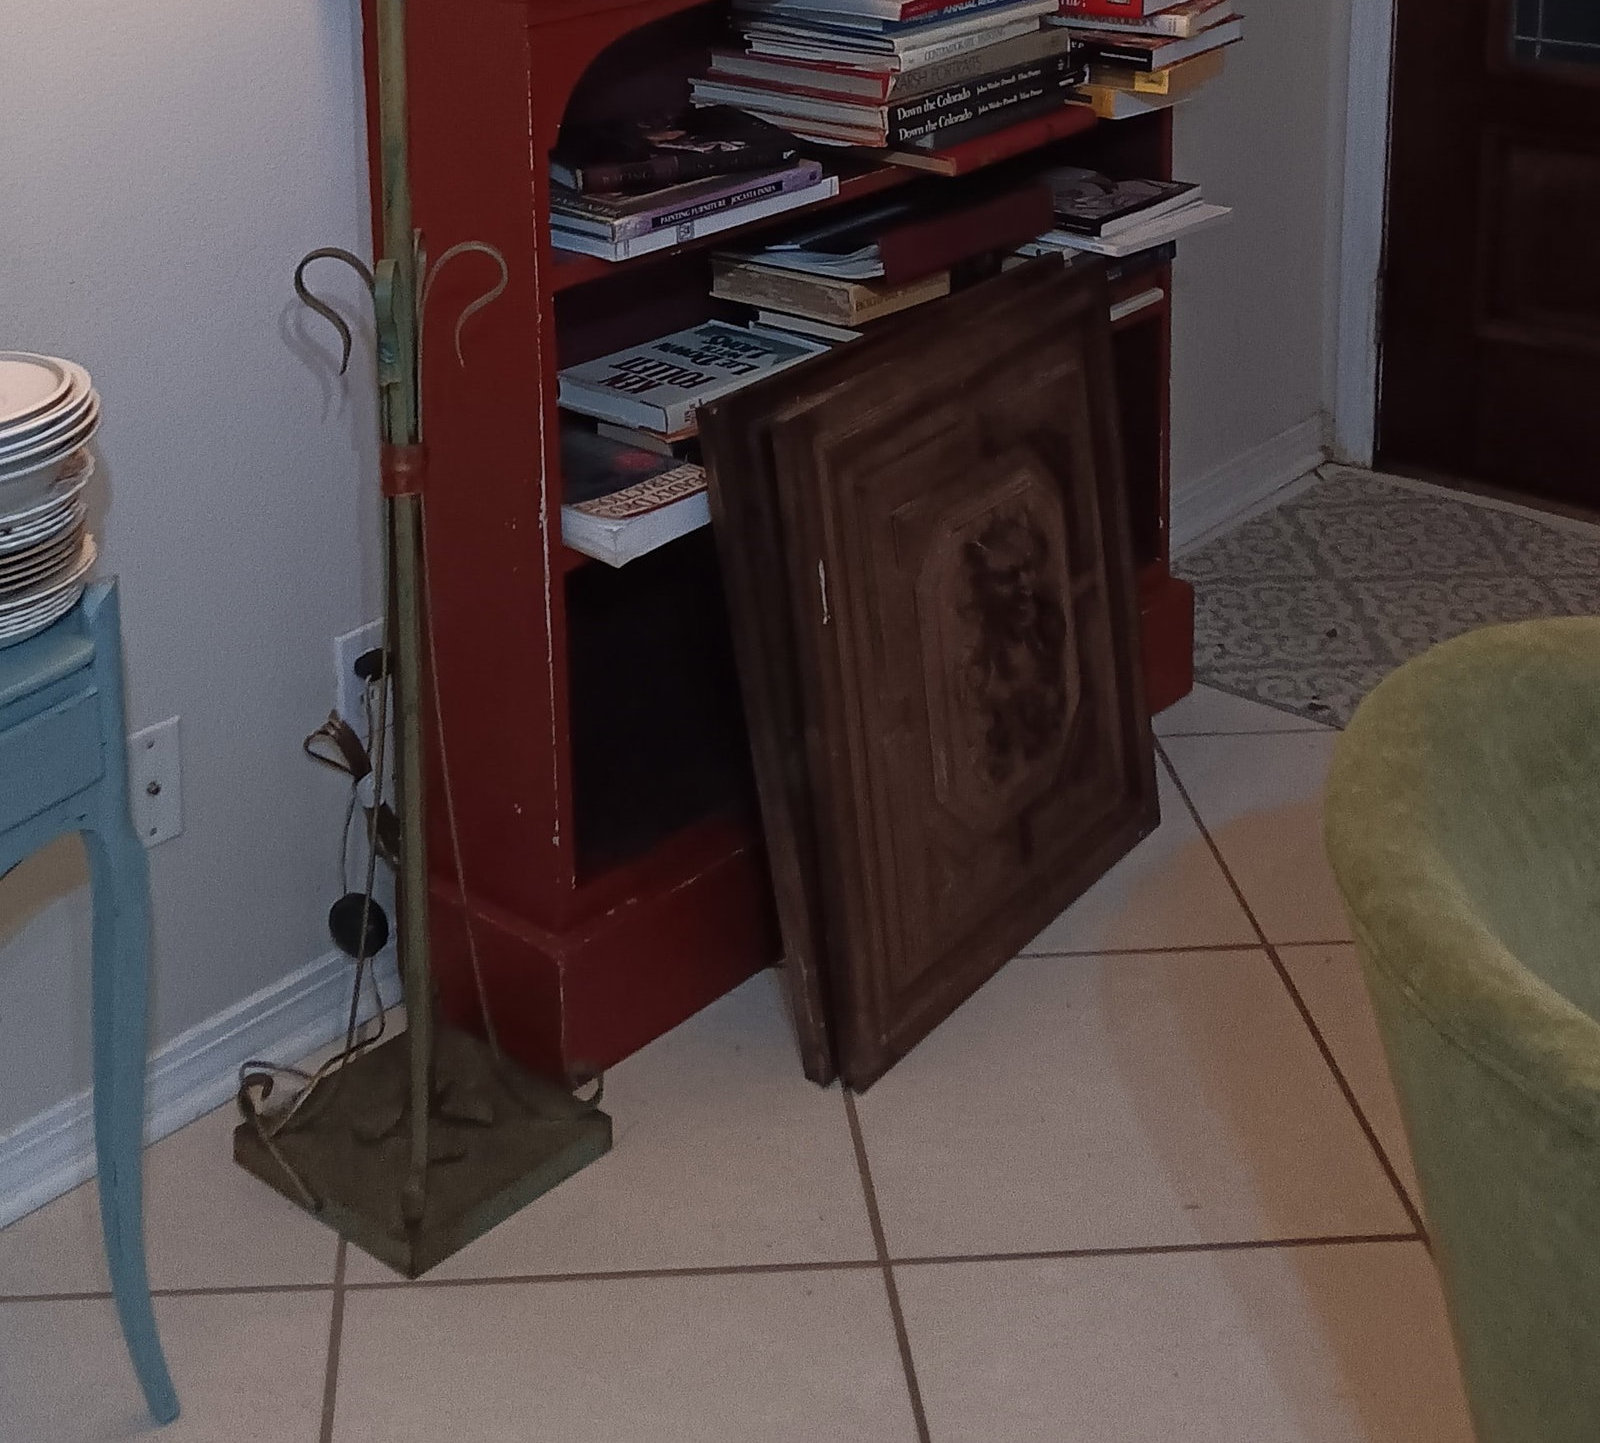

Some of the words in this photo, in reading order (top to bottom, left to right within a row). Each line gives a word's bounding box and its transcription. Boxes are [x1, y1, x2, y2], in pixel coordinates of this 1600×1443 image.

[896, 105, 922, 122] Down
[922, 98, 936, 116] the
[936, 86, 971, 108] Colorado
[898, 125, 924, 142] Down
[924, 117, 938, 134] the
[938, 107, 973, 129] Colorado
[659, 209, 691, 225] PAINTING
[690, 199, 727, 218] FURNITURE
[597, 373, 662, 396] KEN
[608, 357, 716, 390] FOLLETT
